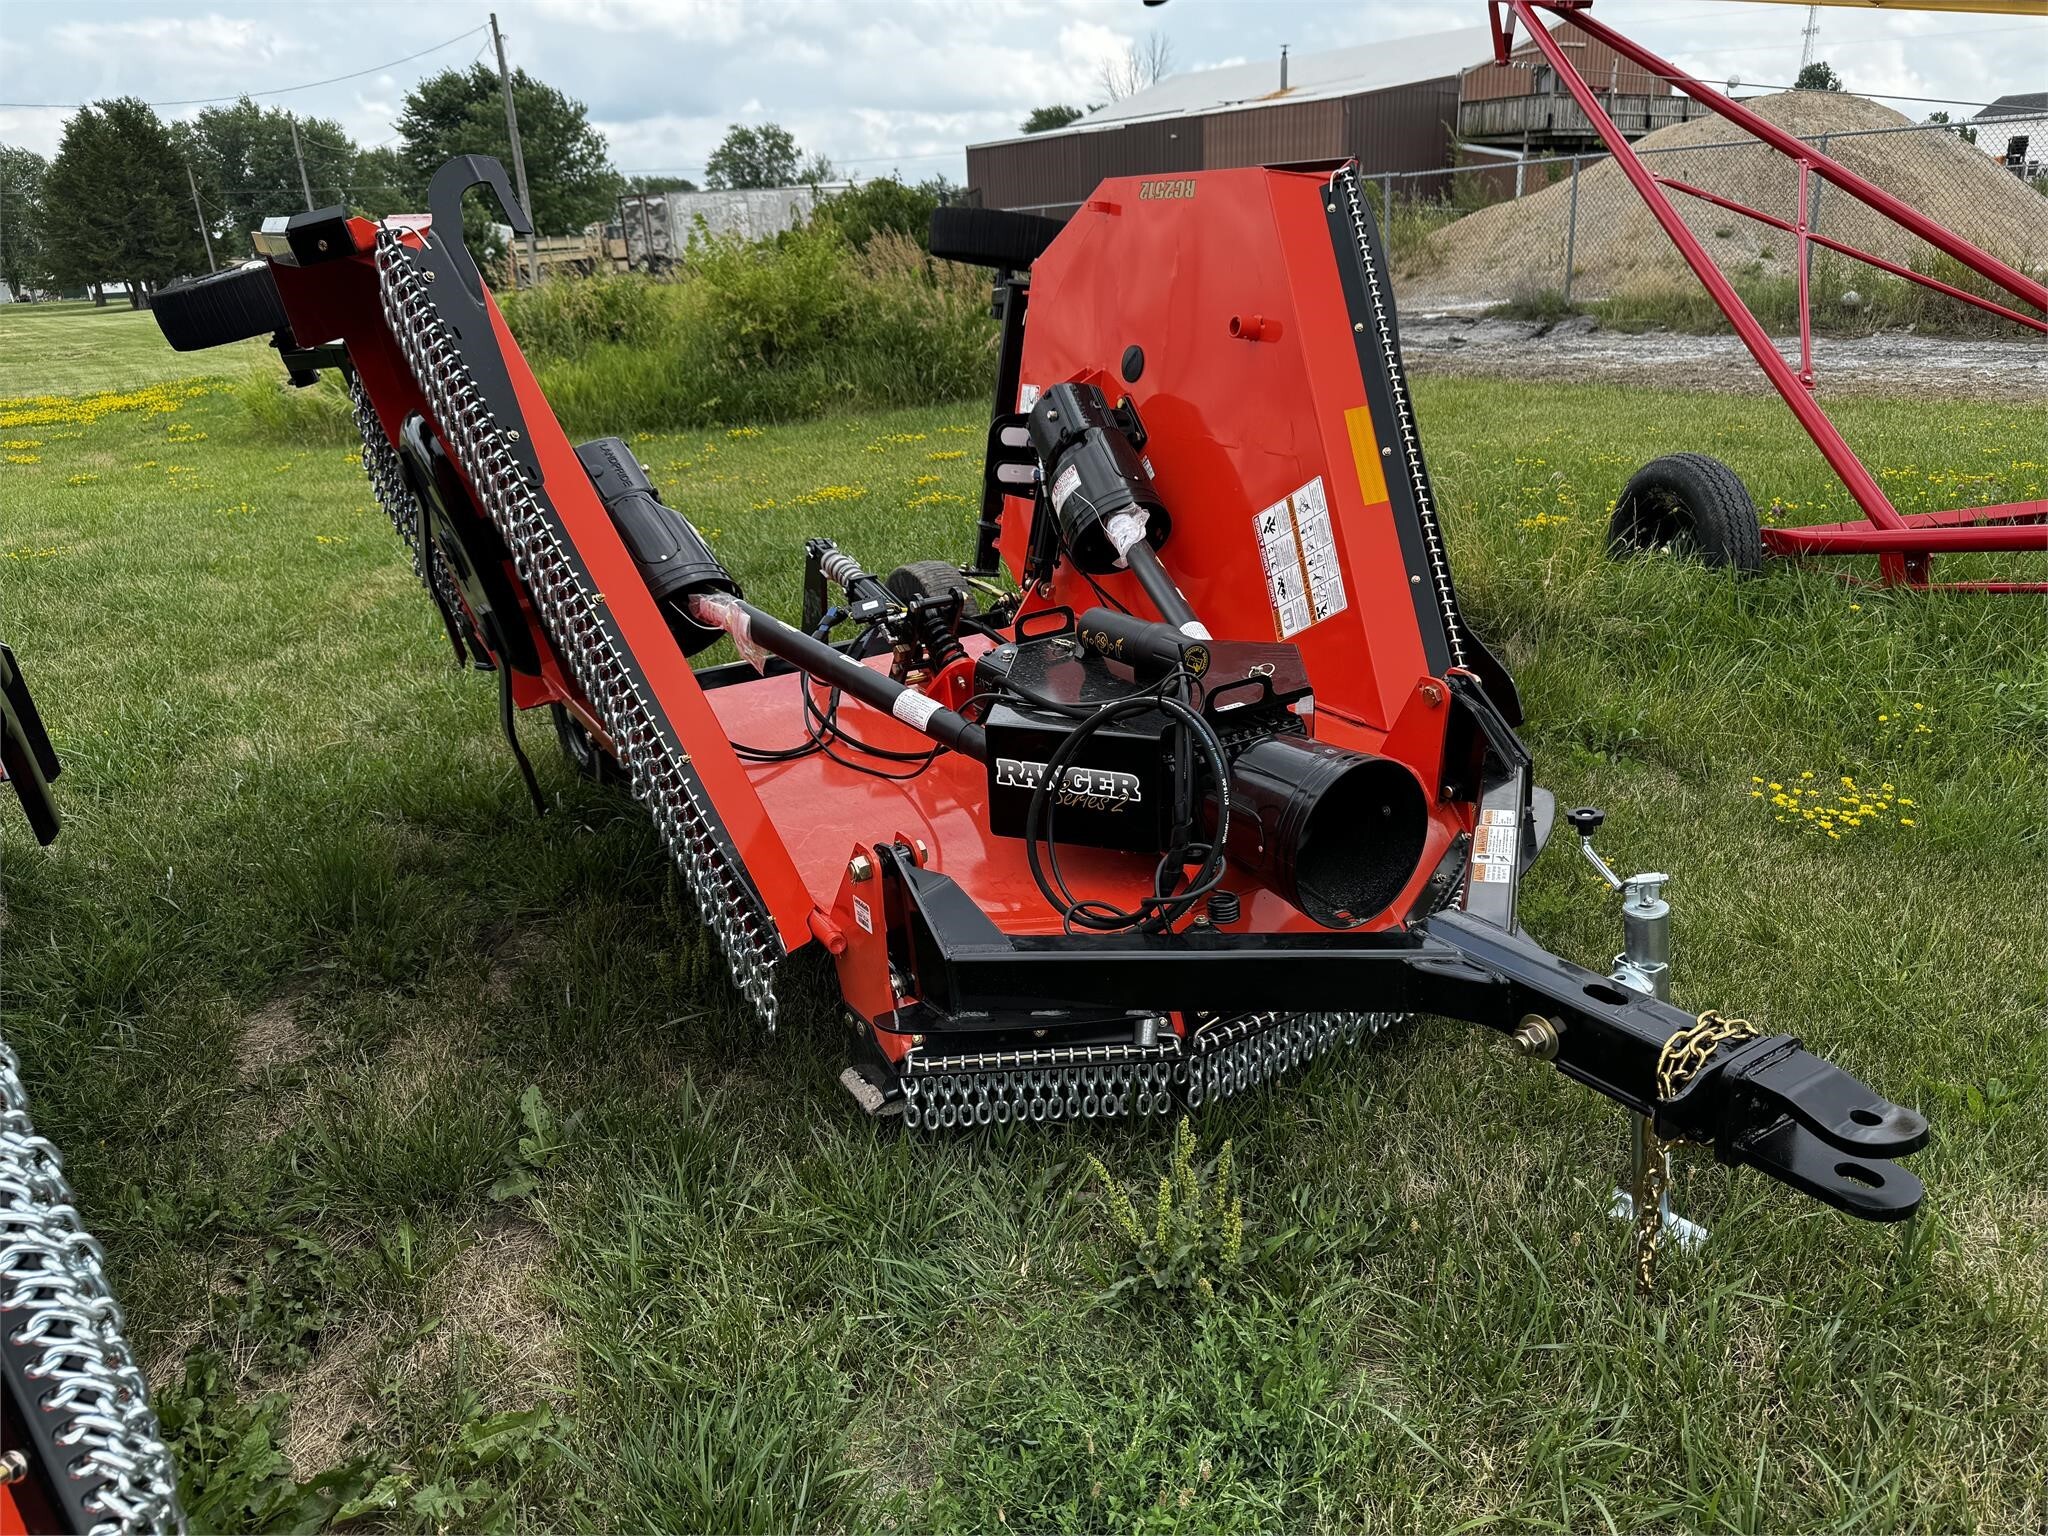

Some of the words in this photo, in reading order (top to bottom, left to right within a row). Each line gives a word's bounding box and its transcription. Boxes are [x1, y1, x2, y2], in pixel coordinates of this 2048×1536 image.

[1139, 179, 1196, 200] RC2512
[599, 442, 634, 488] LANDPRIDE
[1254, 517, 1263, 542] DANGER
[1260, 547, 1269, 572] DANGER
[1267, 577, 1276, 602] DANGER
[1056, 780, 1110, 812] Series
[1111, 793, 1130, 812] 2
